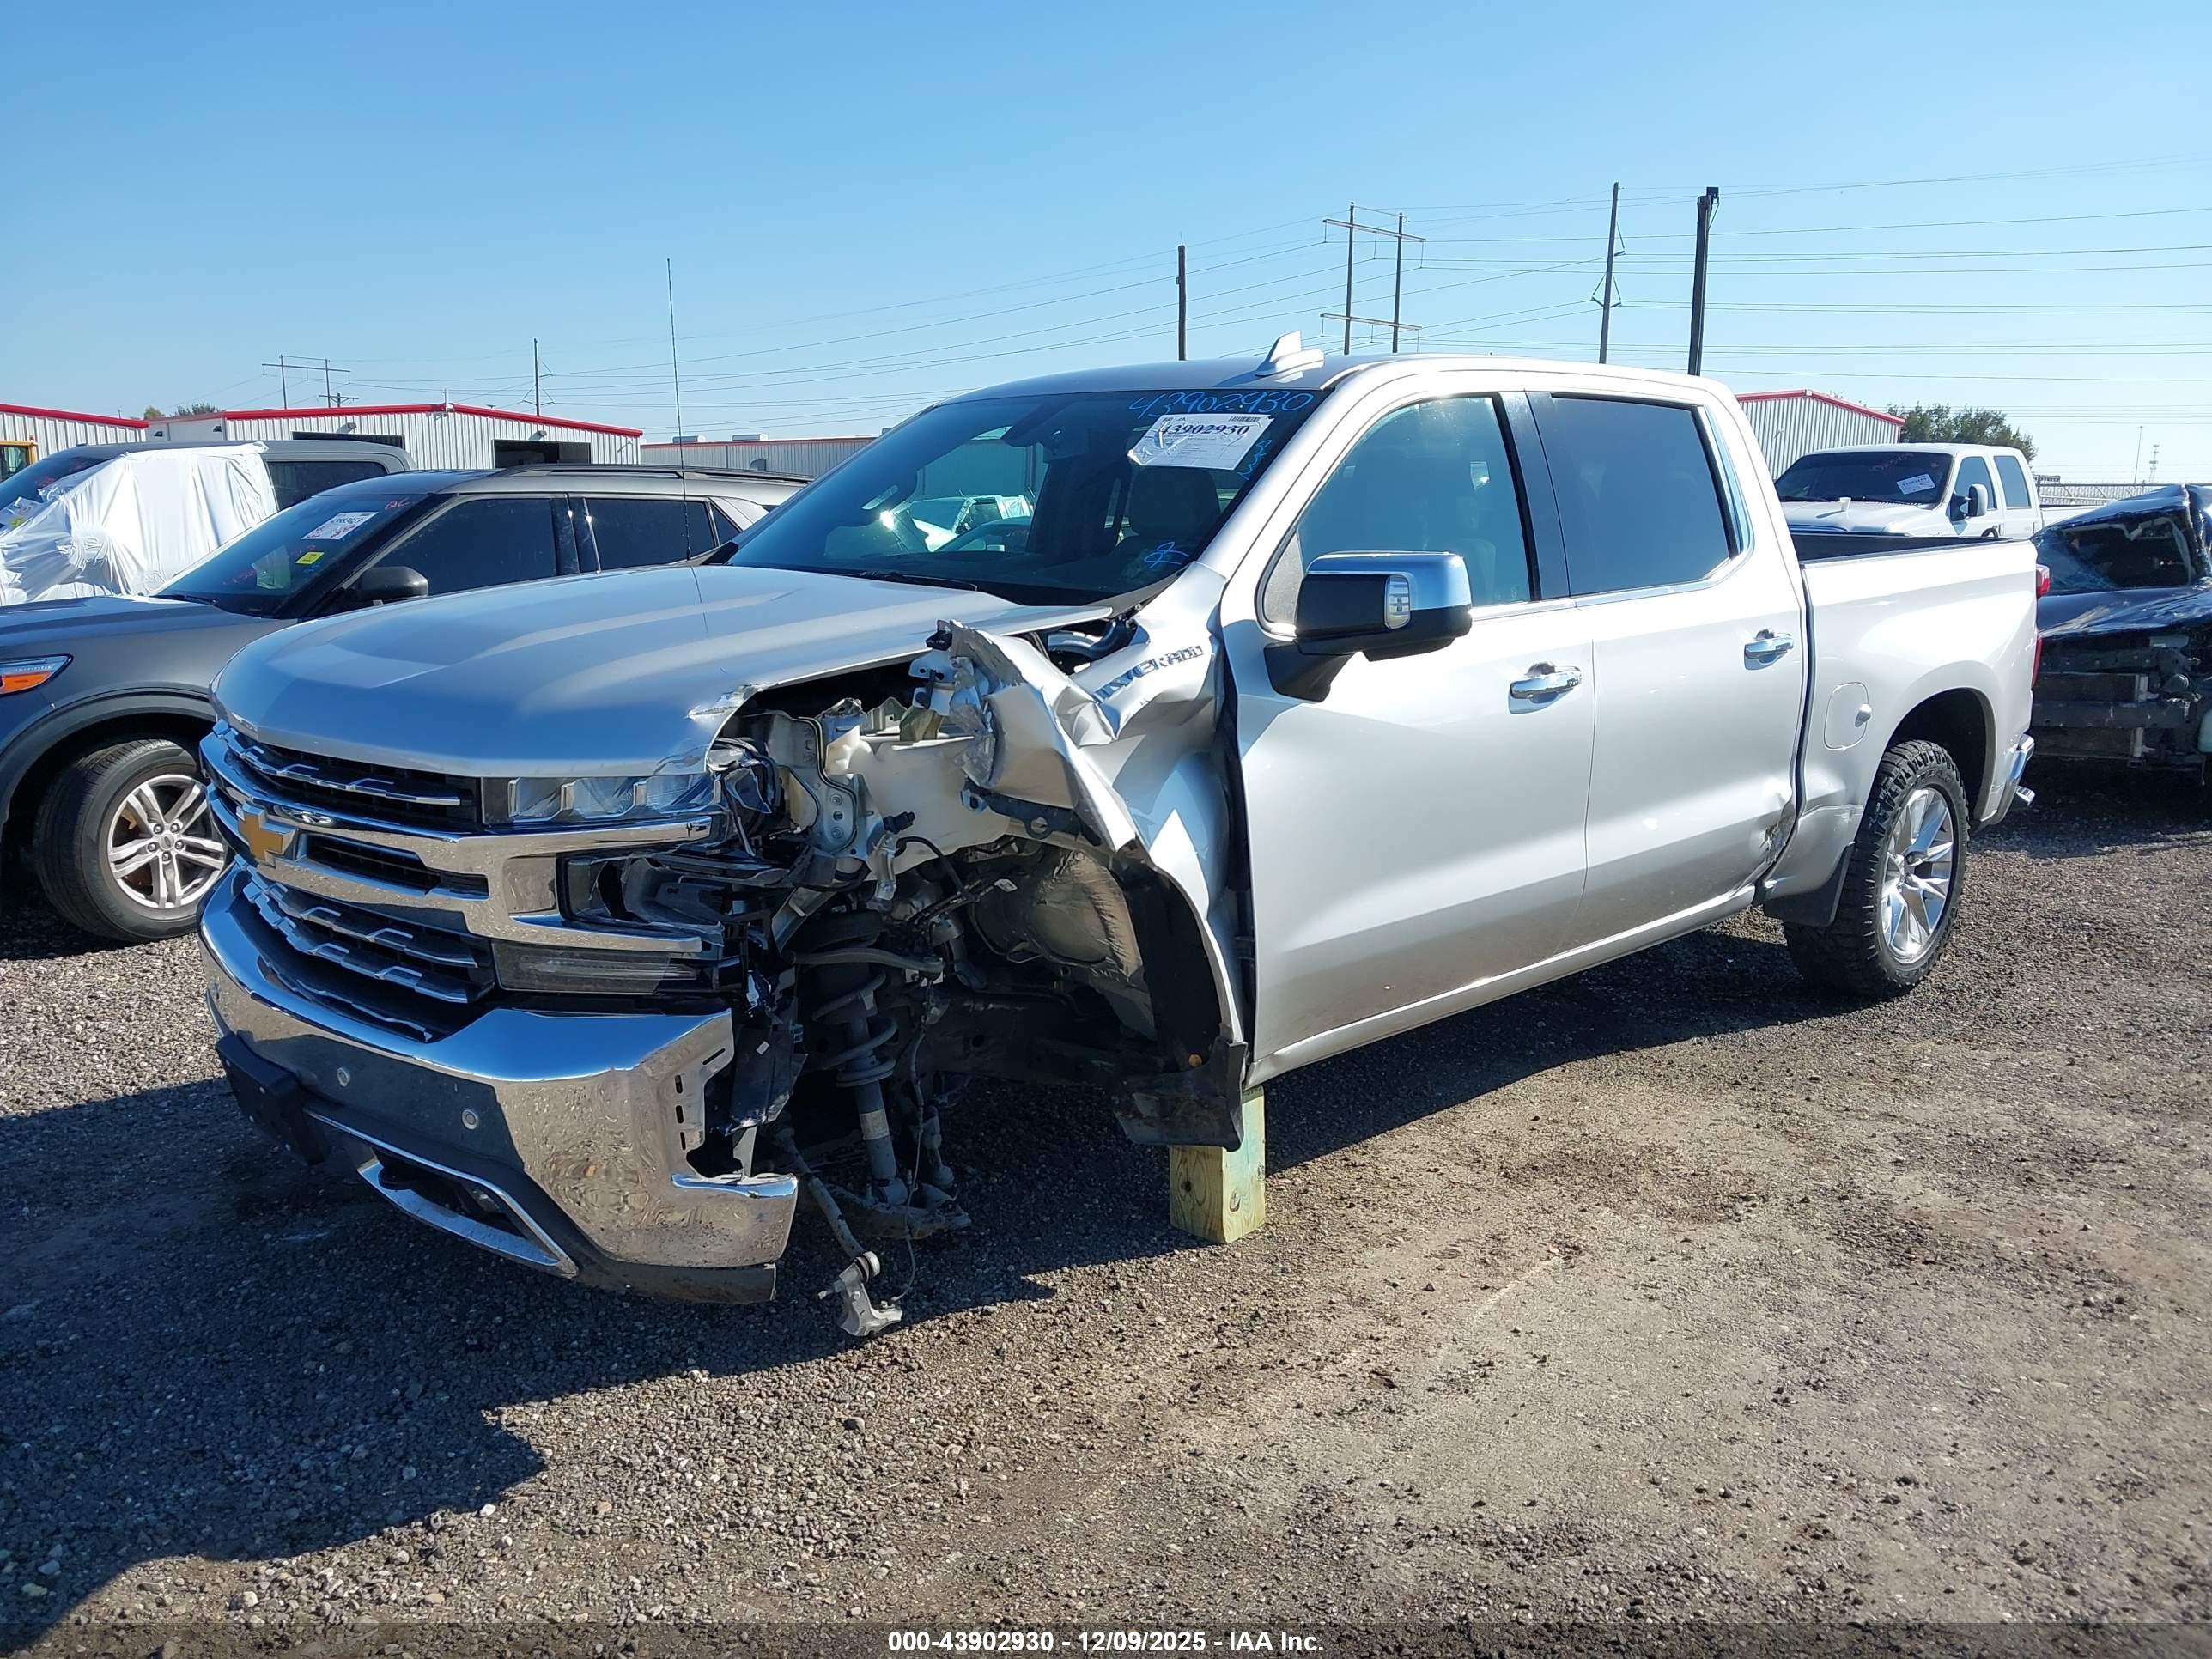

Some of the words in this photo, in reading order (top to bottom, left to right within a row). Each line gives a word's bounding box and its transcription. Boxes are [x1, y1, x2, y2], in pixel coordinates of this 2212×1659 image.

[1128, 391, 1315, 420] 43902930
[1161, 423, 1250, 436] 43902930
[1093, 646, 1204, 702] ILVERADO
